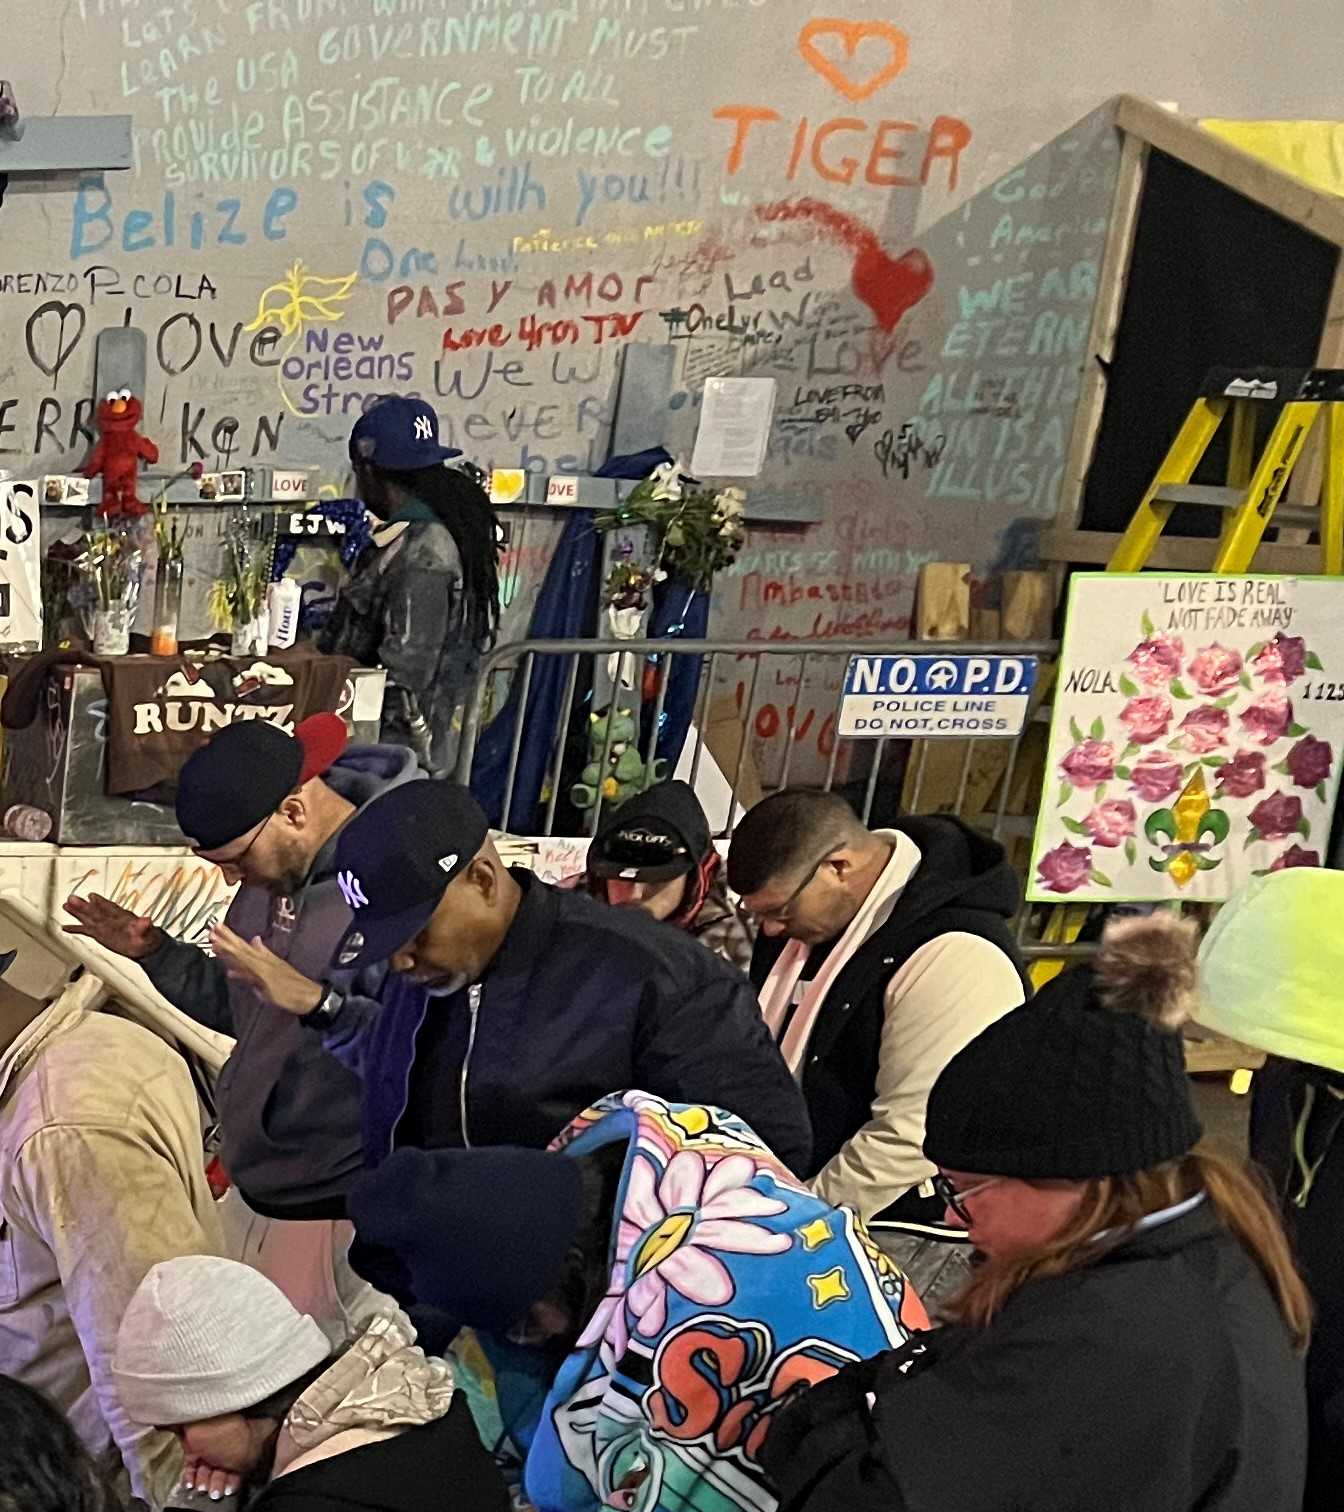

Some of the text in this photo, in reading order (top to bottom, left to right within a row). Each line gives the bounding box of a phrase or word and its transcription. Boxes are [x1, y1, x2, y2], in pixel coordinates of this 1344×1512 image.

[714, 105, 974, 191] TIGER
[70, 178, 299, 260] Belize
[306, 328, 386, 353] New
[273, 479, 308, 493] LOVE
[288, 514, 347, 536] EJW
[1214, 581, 1238, 603] IS
[1167, 608, 1205, 631] NOT
[1204, 606, 1246, 630] FADE
[851, 658, 1028, 694] N.O. P.D.
[132, 700, 296, 738] RUNTZ
[872, 700, 998, 713] POLICE LINE
[854, 717, 1008, 731] DO NOT CROSS
